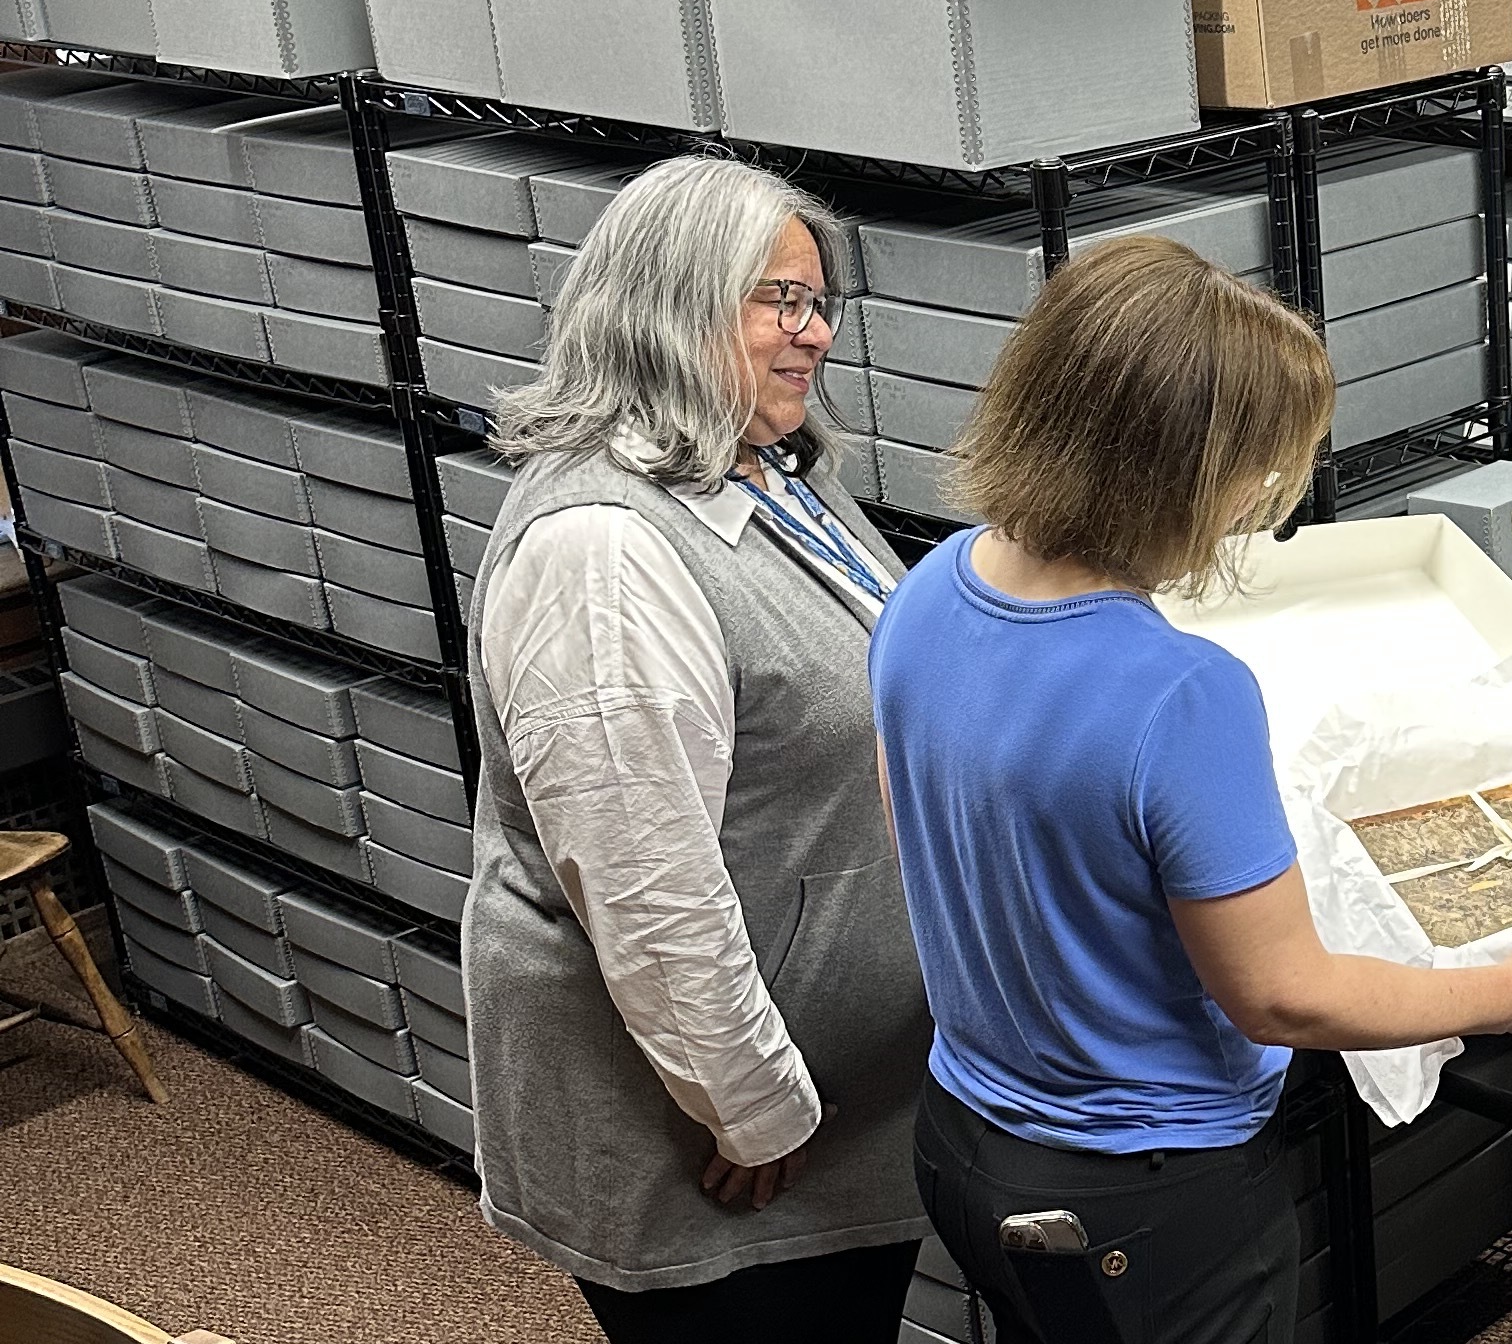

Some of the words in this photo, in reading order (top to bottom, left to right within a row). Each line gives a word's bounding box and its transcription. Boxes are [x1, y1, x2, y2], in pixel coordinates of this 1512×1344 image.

[1370, 13, 1397, 30] How
[1399, 8, 1431, 25] doers
[1361, 34, 1380, 55] get
[1382, 31, 1411, 48] more
